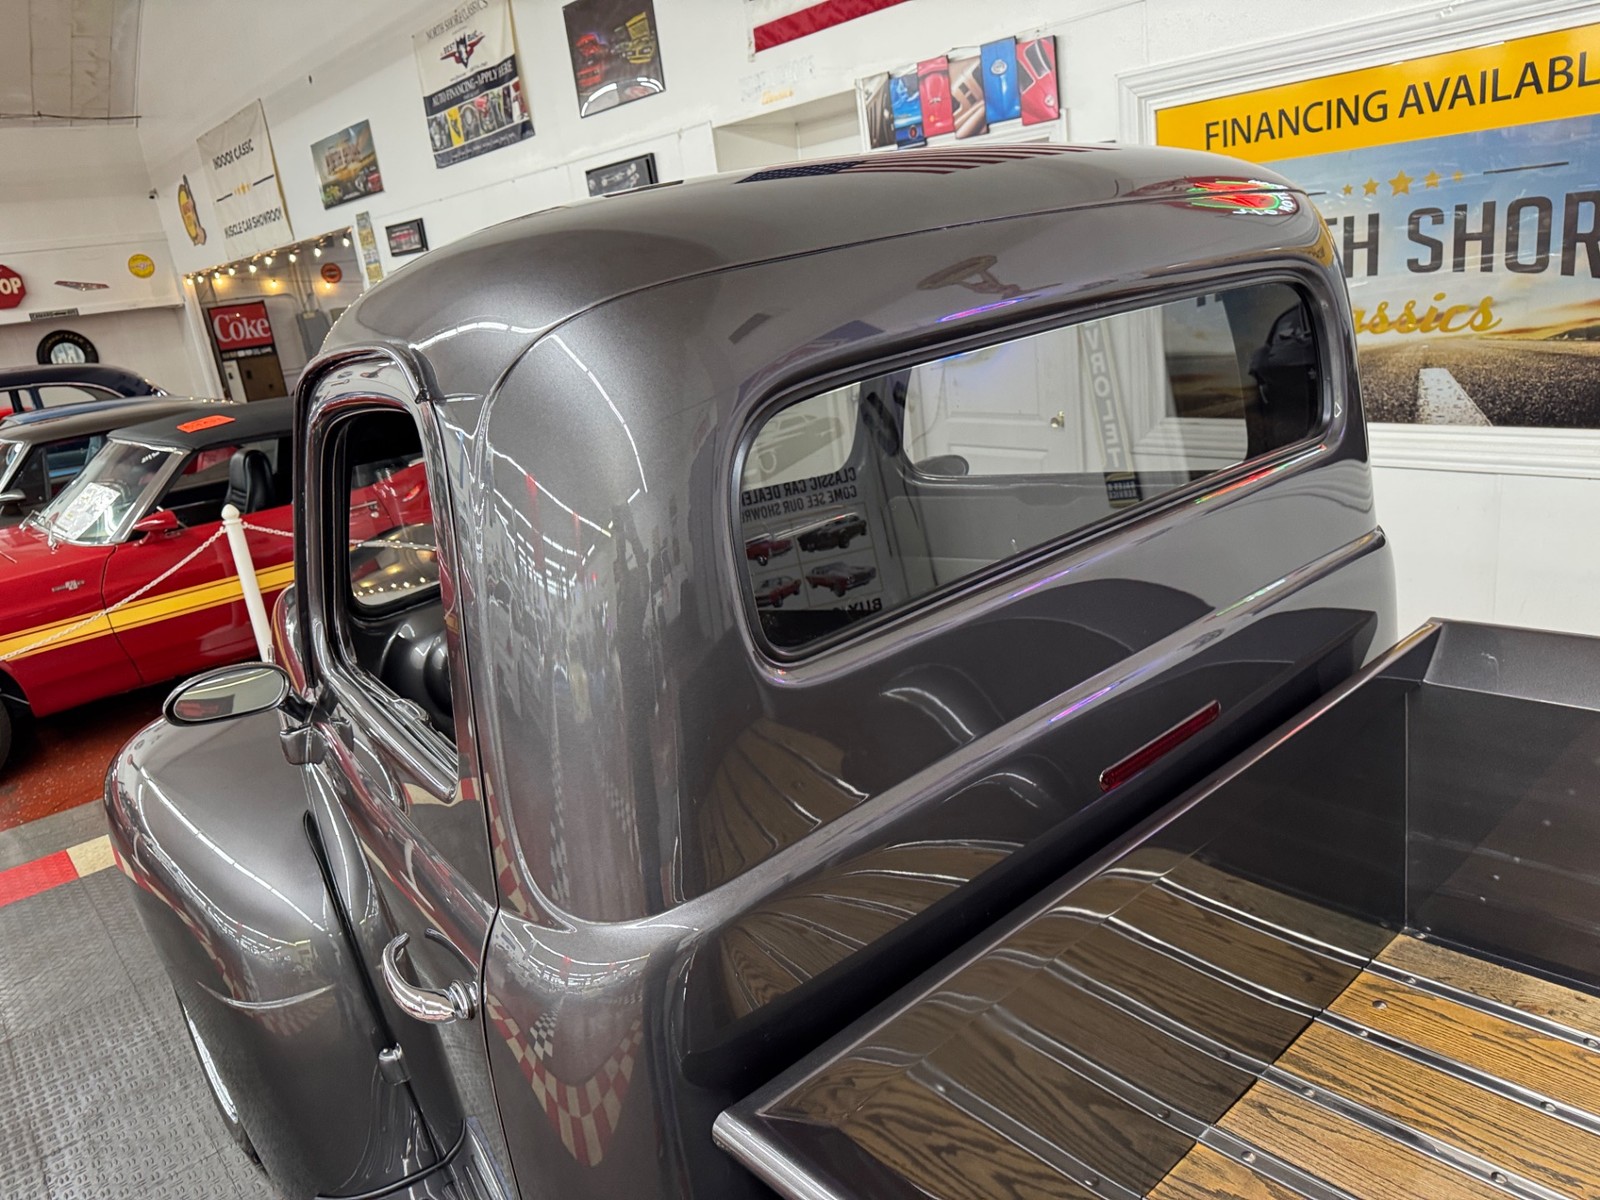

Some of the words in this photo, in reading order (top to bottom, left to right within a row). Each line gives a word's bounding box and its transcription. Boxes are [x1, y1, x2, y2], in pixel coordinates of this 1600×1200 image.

[1205, 89, 1388, 151] FINANCING
[1398, 51, 1600, 119] AVAILABL
[1407, 190, 1600, 279] SHOR
[213, 314, 271, 343] Coke
